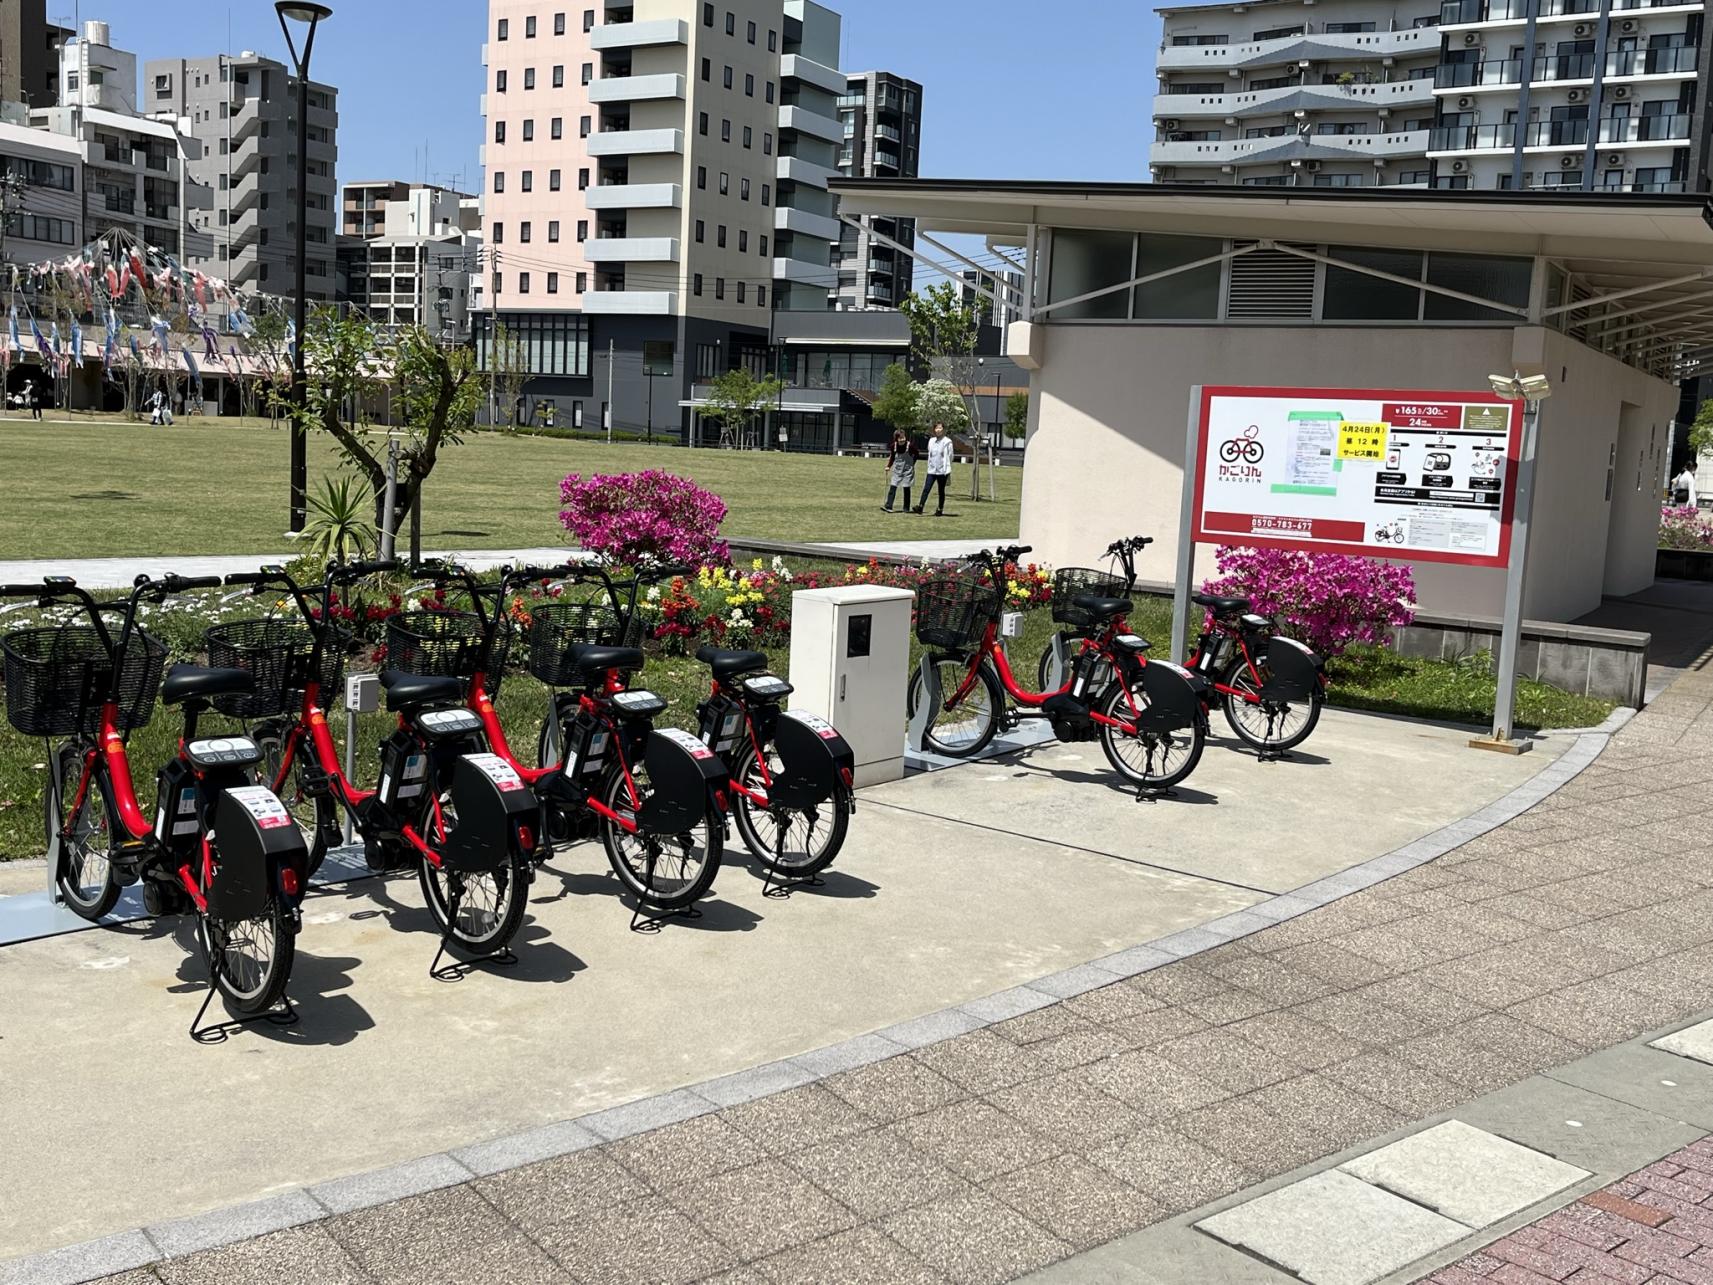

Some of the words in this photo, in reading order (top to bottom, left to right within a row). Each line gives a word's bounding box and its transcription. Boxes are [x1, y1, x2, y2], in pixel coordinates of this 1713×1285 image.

[1343, 449, 1379, 457] サービス開始
[1219, 464, 1262, 477] かごりん
[1218, 476, 1261, 484] KAGORIN
[1251, 518, 1312, 530] 0570-783-677
